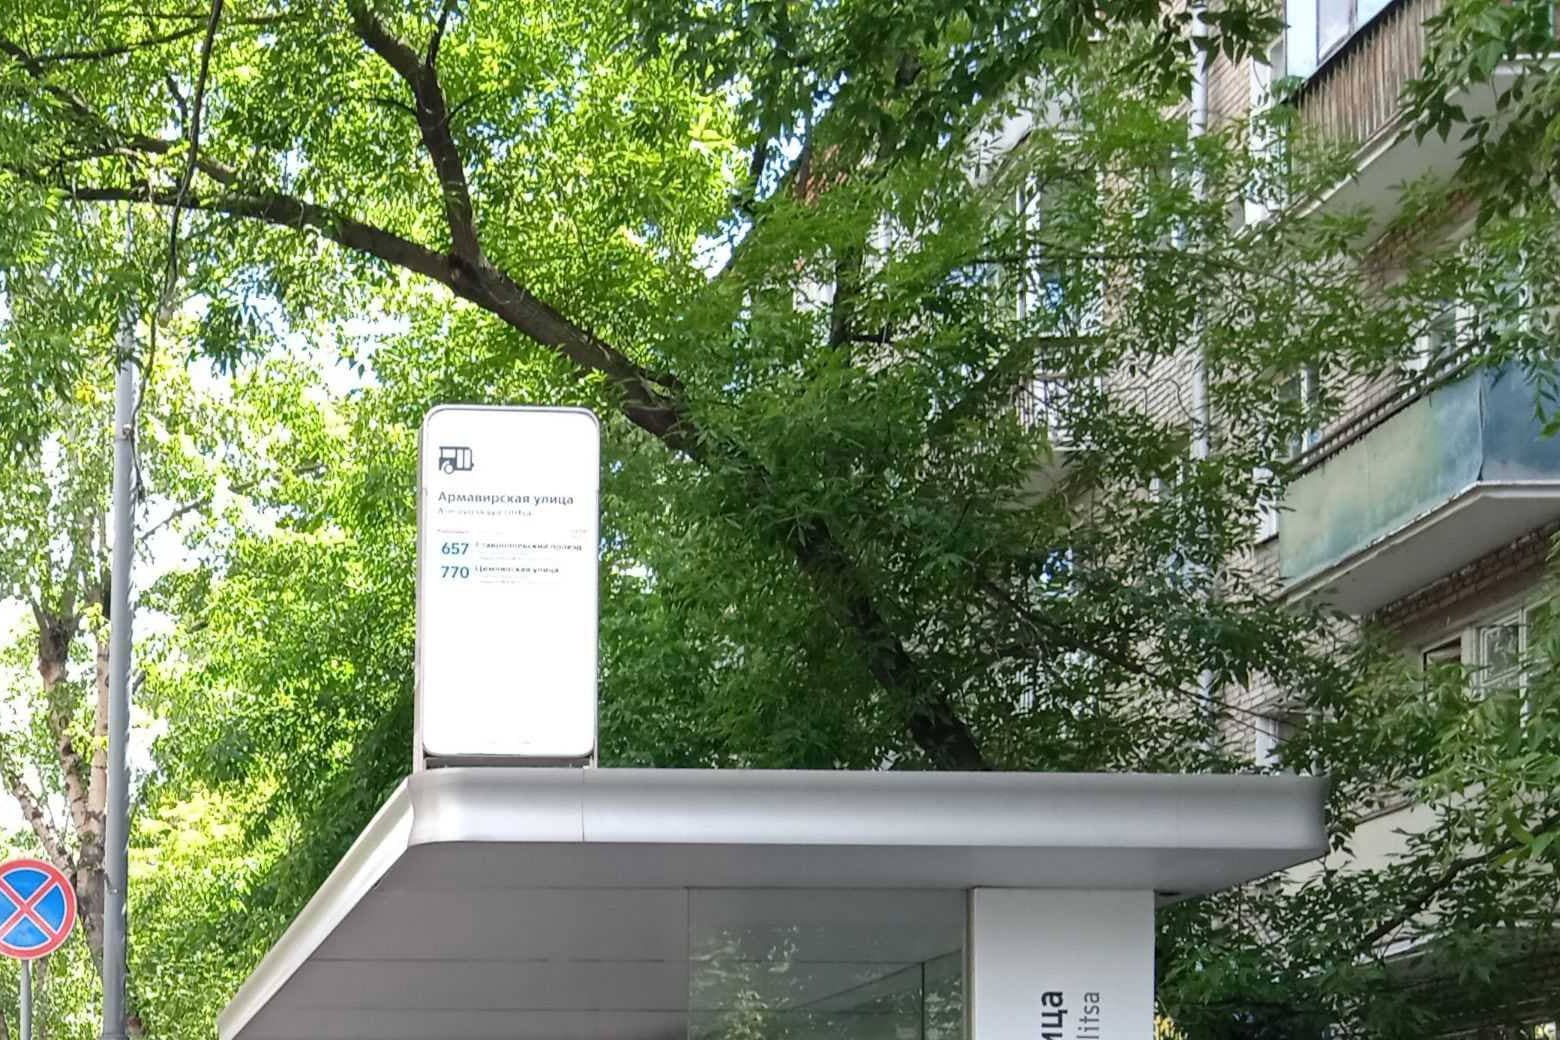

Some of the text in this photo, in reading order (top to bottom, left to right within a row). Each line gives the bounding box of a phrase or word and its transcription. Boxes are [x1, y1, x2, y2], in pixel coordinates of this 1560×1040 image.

[437, 490, 574, 507] Армавирская улица
[441, 541, 469, 555] 657
[441, 565, 470, 579] 770
